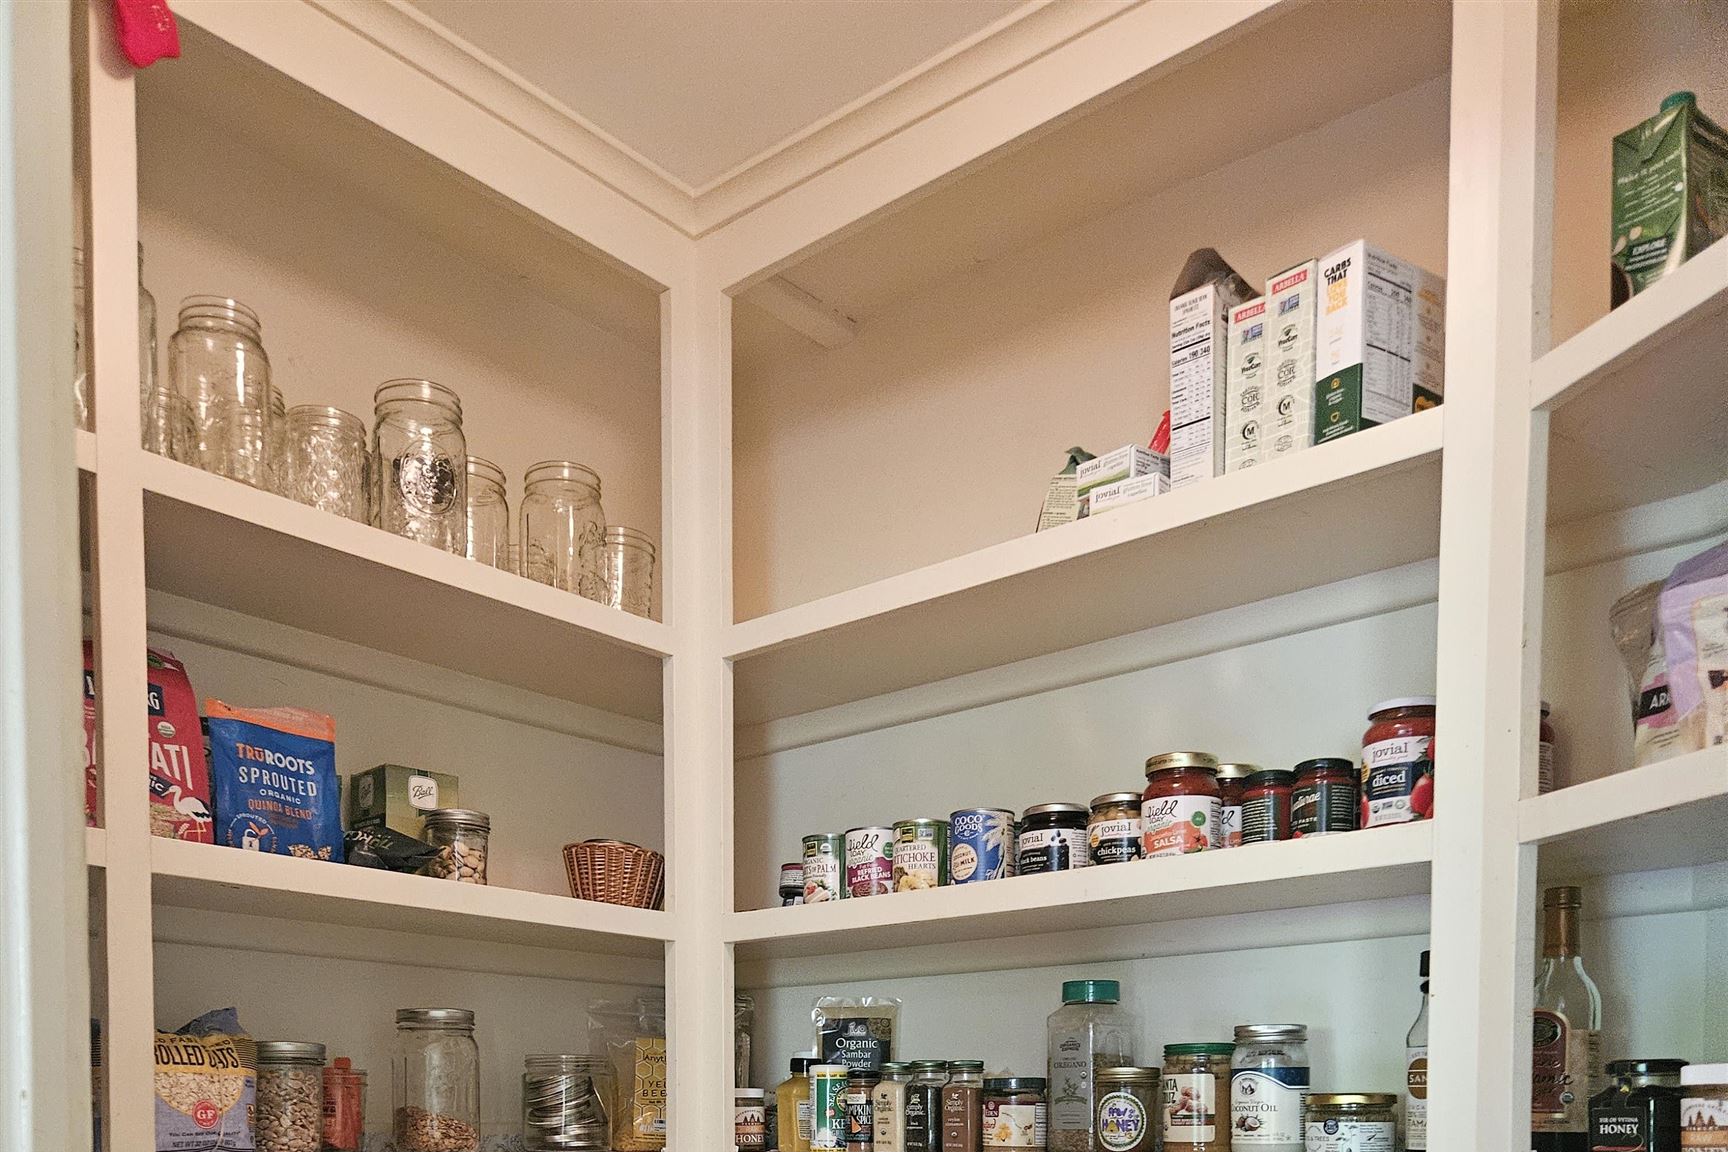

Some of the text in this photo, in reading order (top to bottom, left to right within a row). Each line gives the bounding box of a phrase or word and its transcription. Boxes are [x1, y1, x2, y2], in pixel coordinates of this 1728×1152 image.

[1324, 257, 1351, 278] CARBS
[1327, 269, 1347, 286] THAT
[1372, 742, 1408, 763] jovial
[238, 766, 317, 796] SPROUTED
[1372, 770, 1406, 788] diced
[259, 789, 301, 805] ORGANIC
[412, 785, 435, 800] Ball
[284, 805, 313, 820] BLEND
[954, 815, 983, 826] COCO
[954, 823, 983, 835] GOODS
[1101, 822, 1131, 836] jovial
[1153, 835, 1184, 848] SALSA
[1097, 846, 1136, 857] chickpeas
[960, 857, 975, 866] MILK
[817, 864, 837, 873] PALM
[857, 867, 883, 876] REFRIED
[852, 871, 891, 883] BLACK BEANS
[835, 1037, 878, 1050] Organic
[208, 1047, 239, 1069] OATS
[841, 1050, 871, 1059] Sambar
[841, 1059, 871, 1068] Powder
[1053, 1061, 1087, 1069] OREGANO
[945, 1099, 963, 1108] Simply
[1261, 1103, 1278, 1112] OIL
[196, 1109, 214, 1120] GF
[856, 1115, 872, 1125] SPICE
[1102, 1118, 1140, 1132] HONEY
[1599, 1124, 1639, 1134] HONEY
